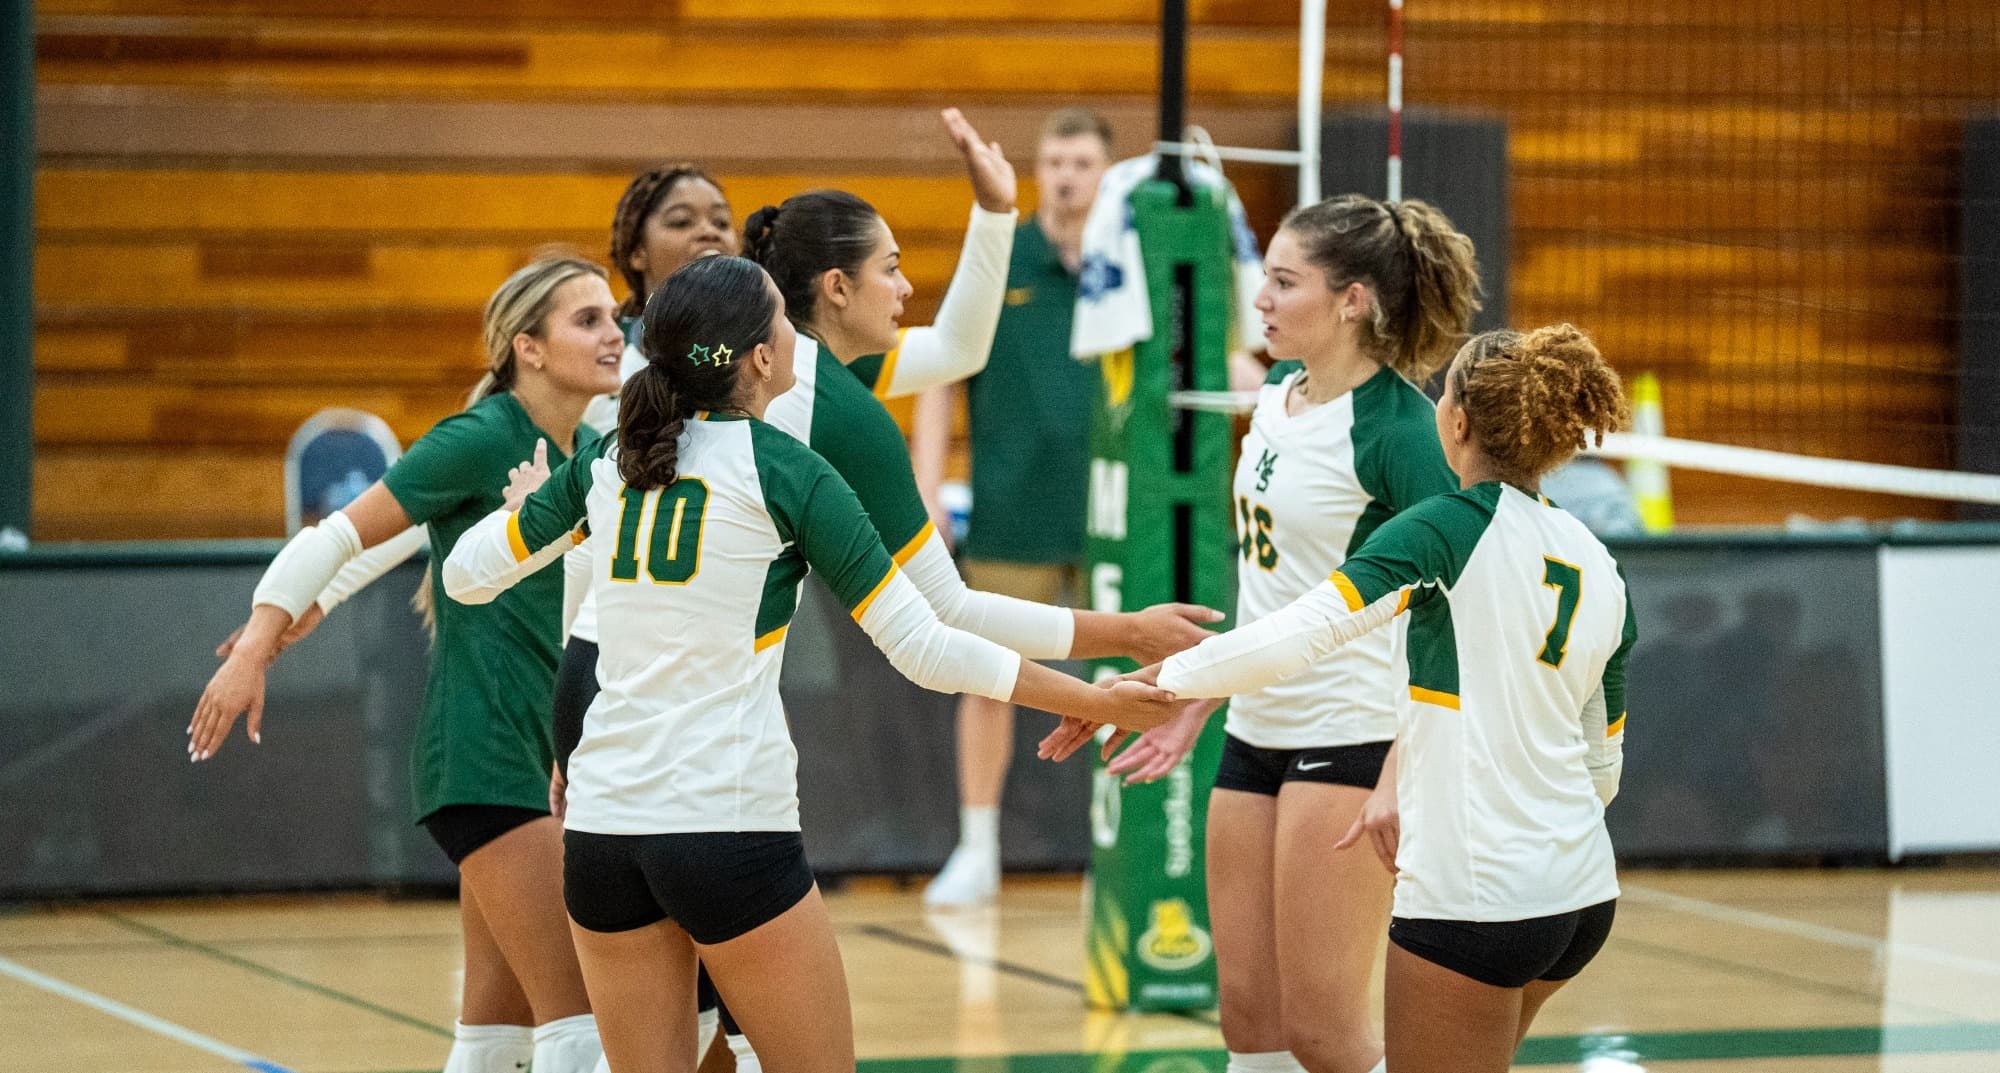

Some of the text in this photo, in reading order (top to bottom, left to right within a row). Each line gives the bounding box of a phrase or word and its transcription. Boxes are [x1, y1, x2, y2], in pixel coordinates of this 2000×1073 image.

[610, 475, 711, 586] 10
[1239, 495, 1279, 573] 16
[1536, 553, 1583, 670] 7
